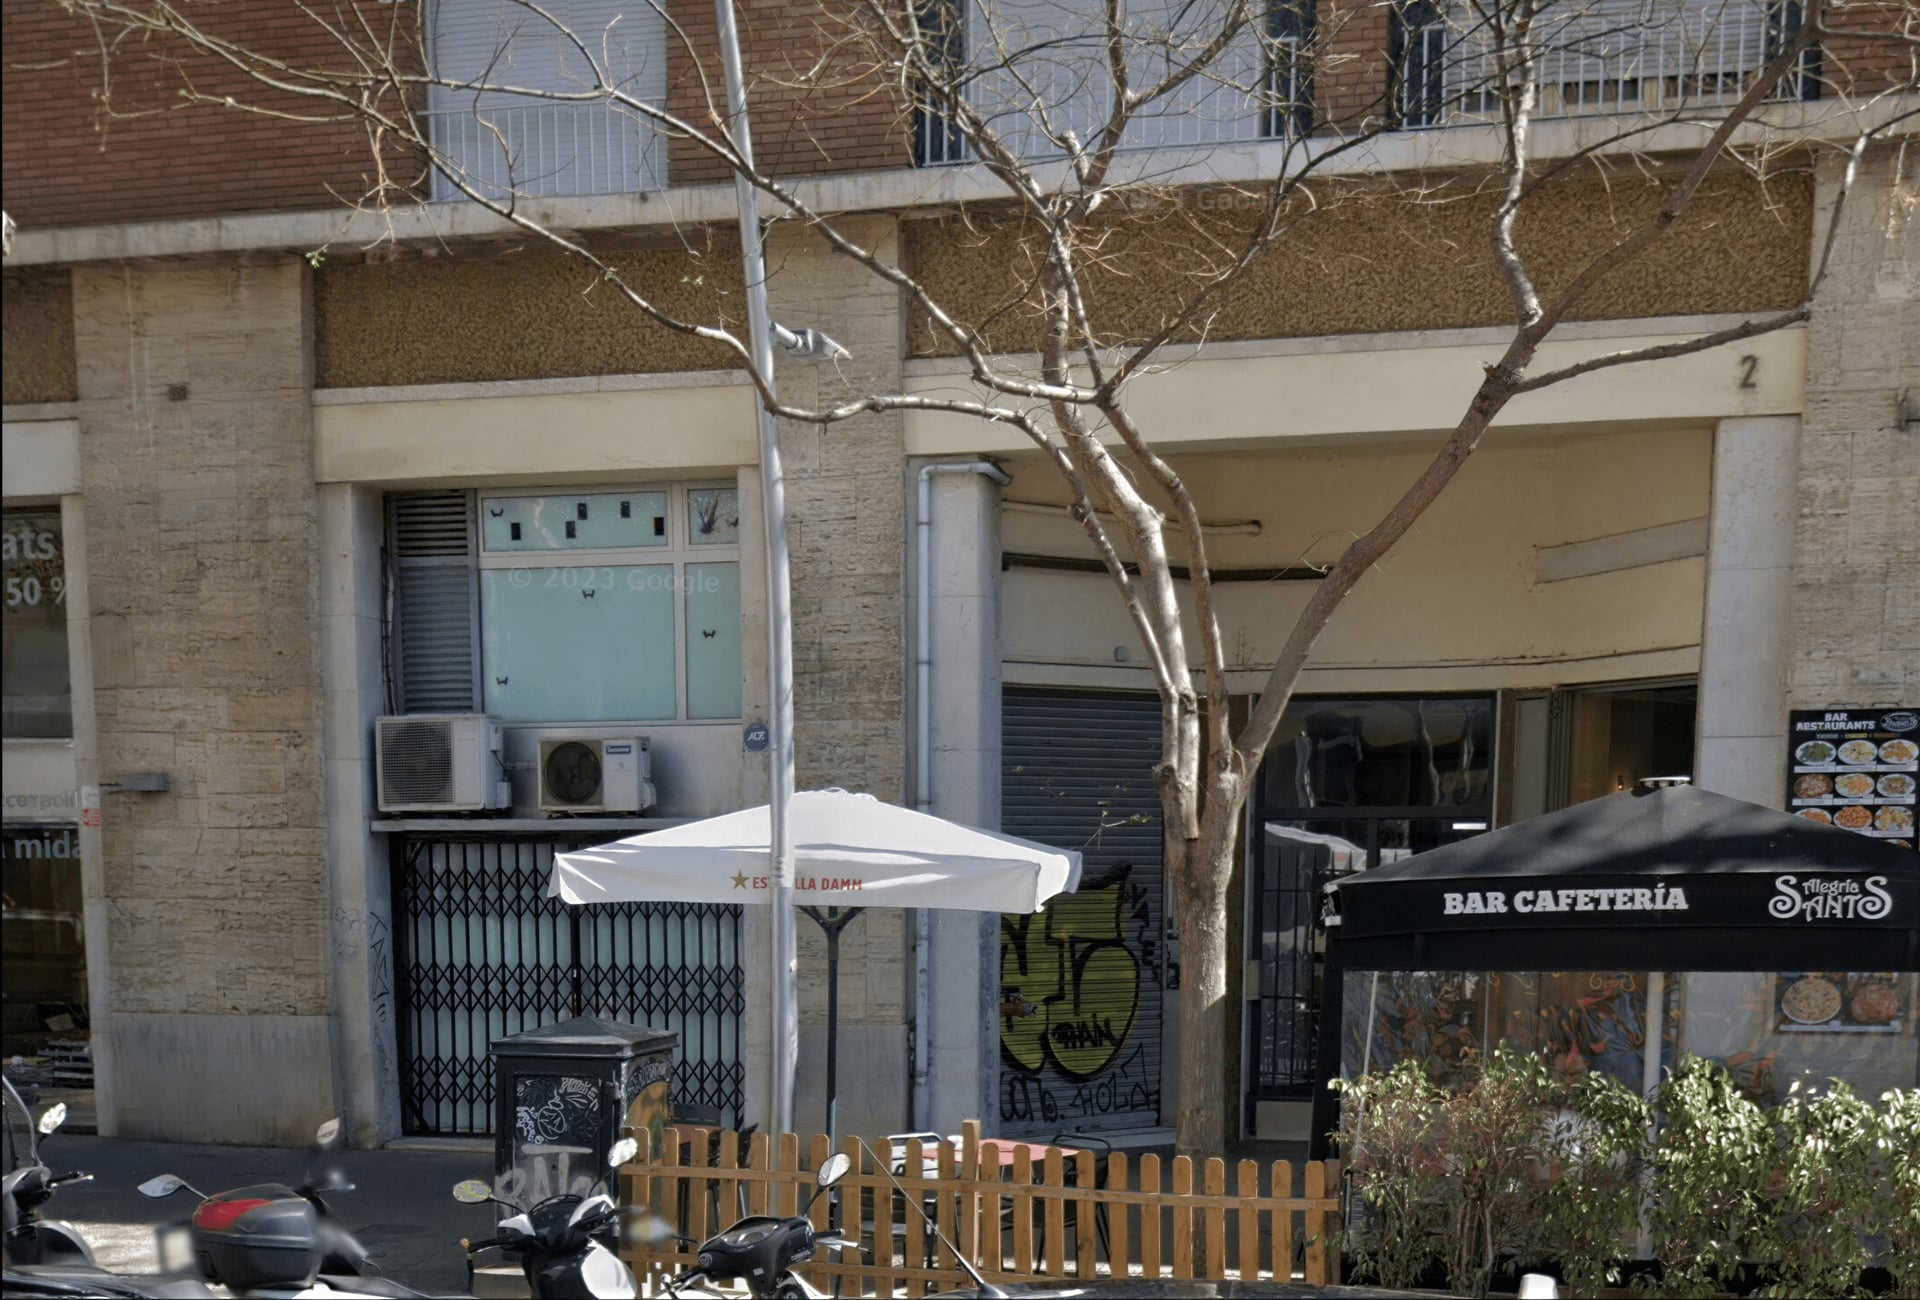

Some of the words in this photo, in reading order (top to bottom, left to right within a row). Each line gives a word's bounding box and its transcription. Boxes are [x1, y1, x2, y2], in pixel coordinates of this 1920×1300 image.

[1740, 354, 1758, 389] 2
[7, 576, 42, 606] 50
[1825, 713, 1848, 722] BAR
[753, 876, 817, 890] ESLLA
[821, 878, 863, 891] DAMM
[1443, 891, 1508, 915] BAR
[1513, 882, 1690, 914] CAFETERÍA
[1768, 875, 1892, 922] SANTS
